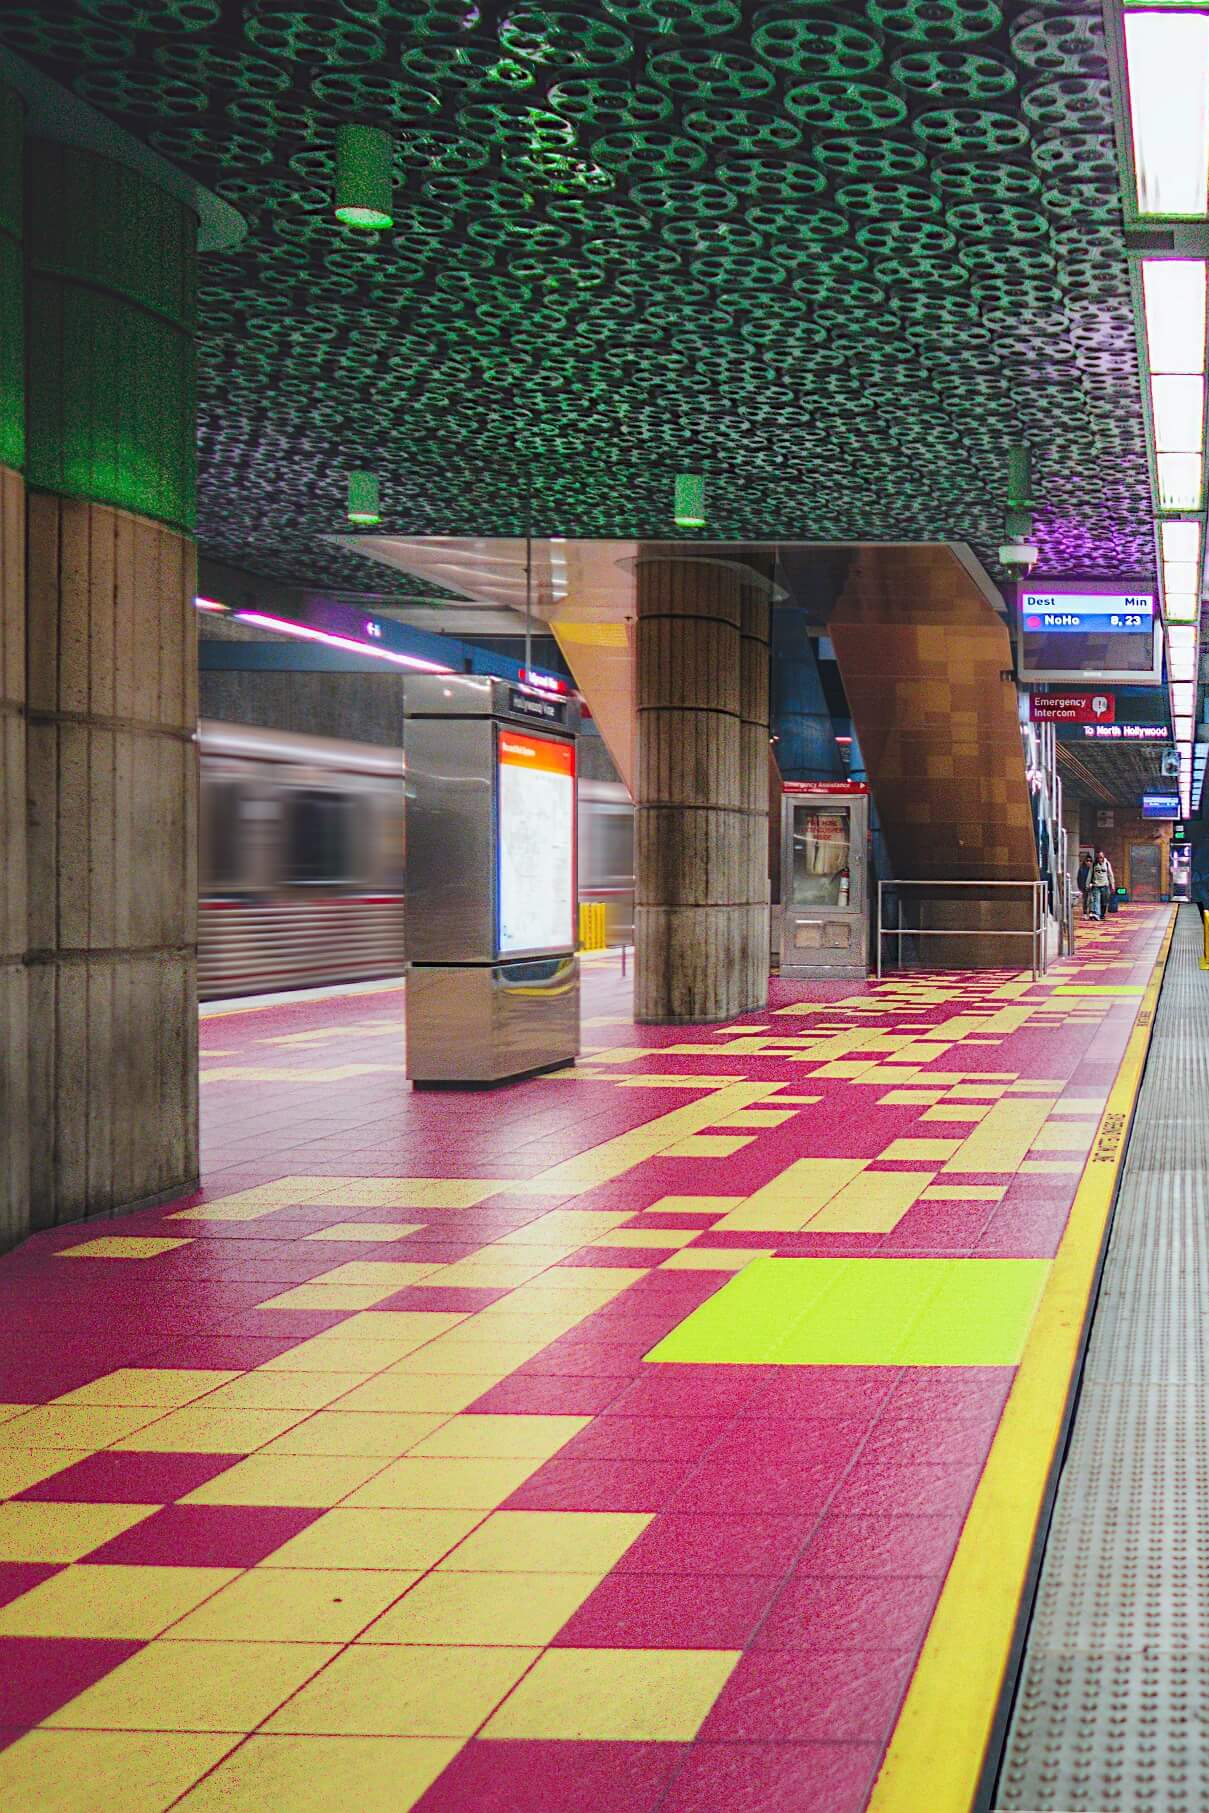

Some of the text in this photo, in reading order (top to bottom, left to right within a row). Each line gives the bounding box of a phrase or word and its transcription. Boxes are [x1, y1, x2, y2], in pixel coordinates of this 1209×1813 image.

[1027, 596, 1147, 607] Dest Min
[1044, 615, 1142, 626] NoHo 8, 23
[1034, 697, 1086, 708] Emergency
[1034, 708, 1076, 717] Intercom
[1083, 725, 1168, 738] To North Hollywood
